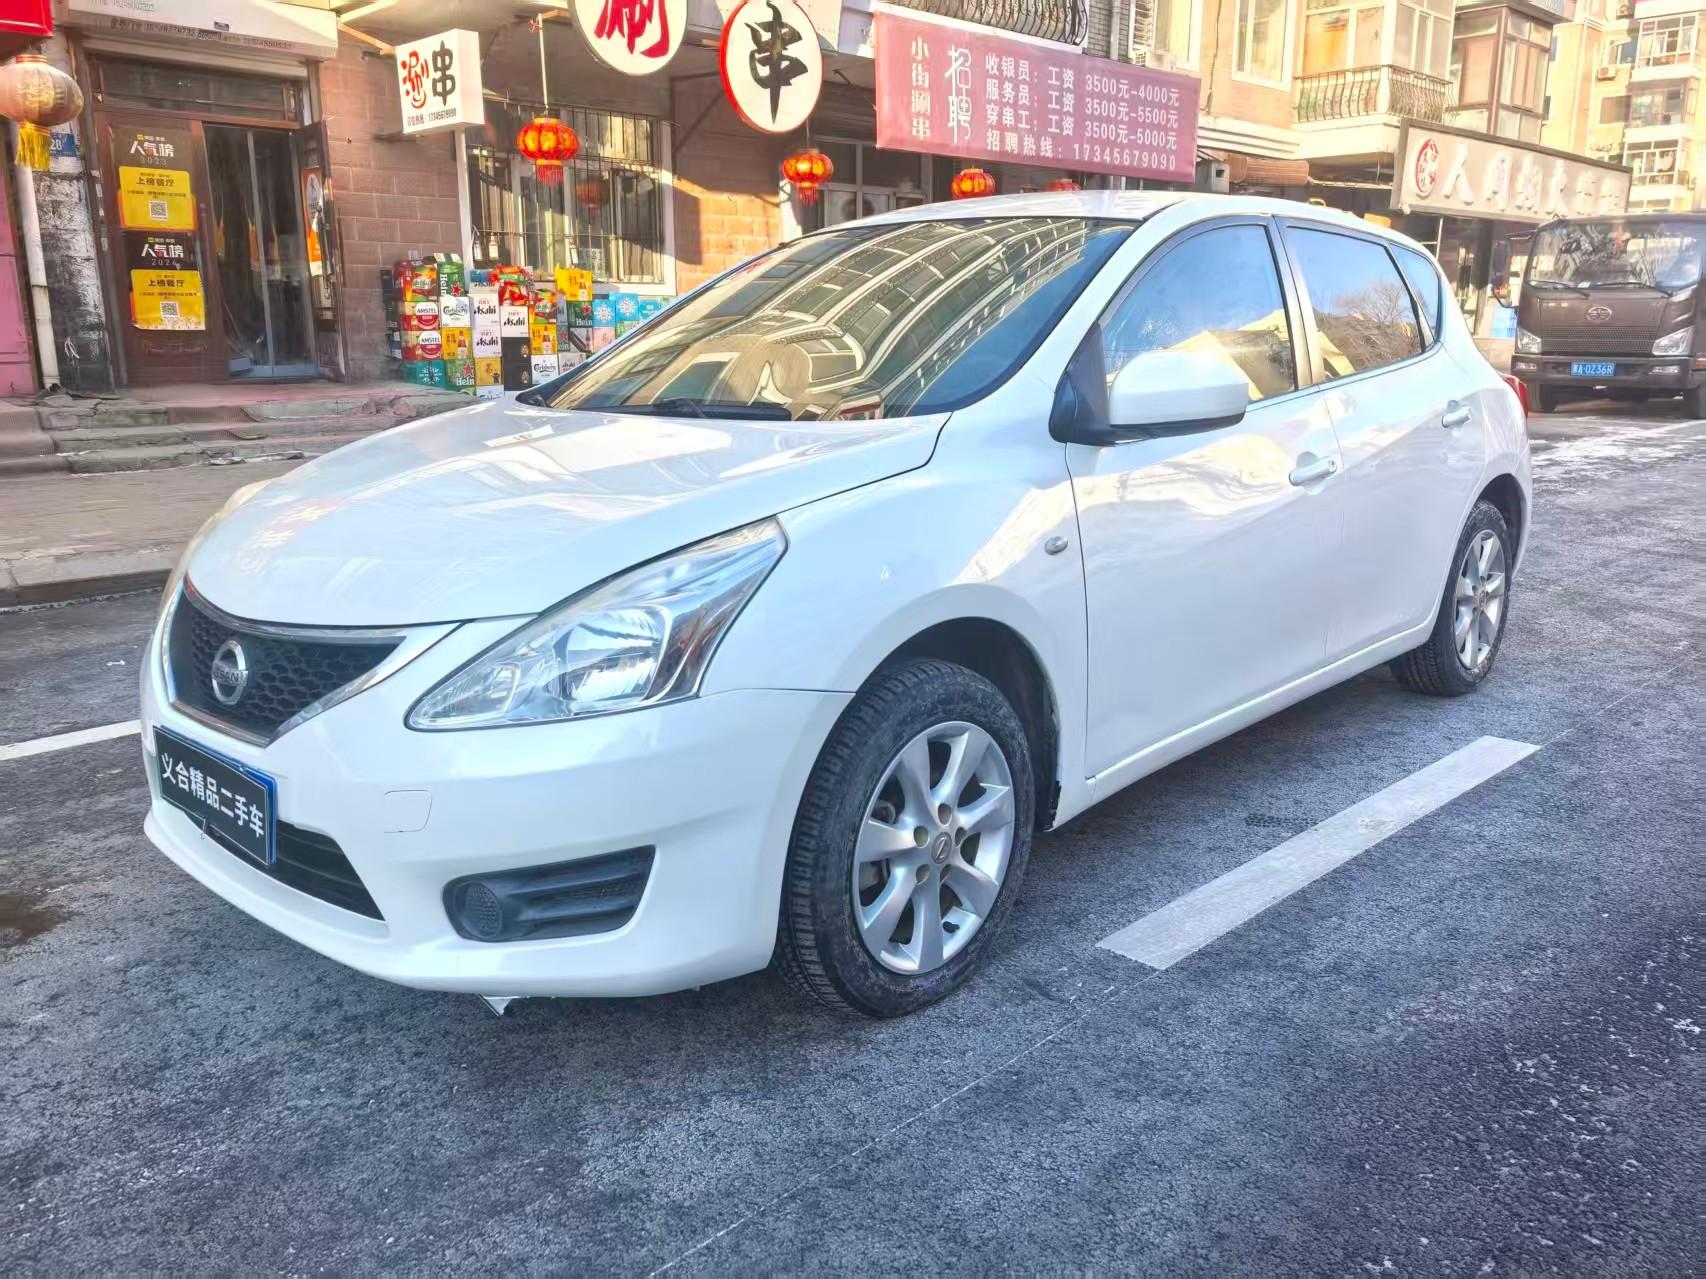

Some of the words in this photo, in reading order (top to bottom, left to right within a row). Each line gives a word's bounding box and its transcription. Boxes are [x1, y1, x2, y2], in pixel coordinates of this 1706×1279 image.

[744, 0, 809, 126] 串
[944, 43, 973, 145] 招聘
[1047, 65, 1076, 89] 工资
[1085, 73, 1181, 107] 3500元-4000元
[1047, 90, 1076, 114] 工资
[1084, 98, 1180, 129] 3500元-5500元
[129, 140, 175, 158] 人气榜
[1047, 114, 1076, 137] 工资
[1084, 120, 1178, 151] 3500元-5000元
[1073, 142, 1177, 171] 17345679090
[141, 243, 184, 258] 人气榜
[473, 305, 497, 316] Asahi
[503, 317, 526, 327] Asahi
[476, 336, 499, 347] Asahi
[160, 752, 265, 839] 义合精品二手车
